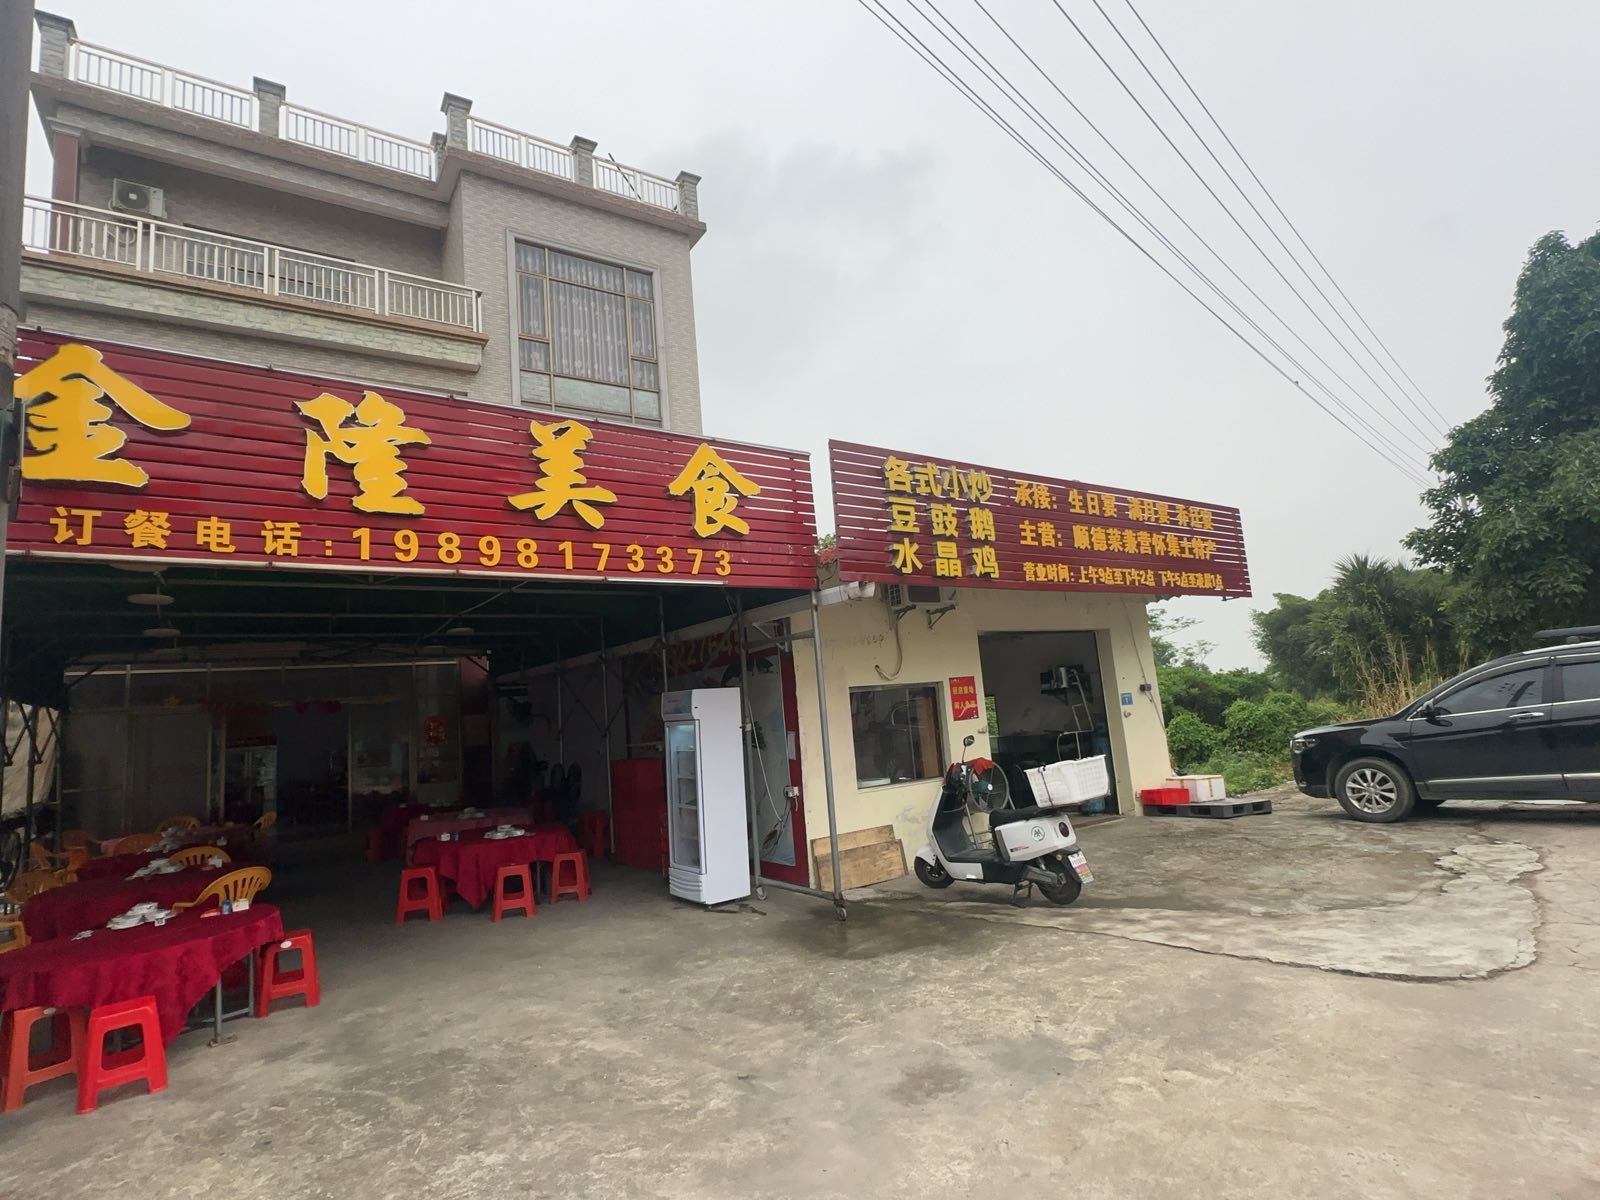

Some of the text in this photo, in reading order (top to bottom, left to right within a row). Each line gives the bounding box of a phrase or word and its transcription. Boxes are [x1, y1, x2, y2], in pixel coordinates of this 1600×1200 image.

[13, 342, 763, 538] 金隆美食
[884, 456, 992, 502] 各式小炒
[887, 497, 996, 542] 豆豉鹅
[1128, 497, 1171, 524] 满月宴
[892, 539, 1000, 579] 水晶鸡
